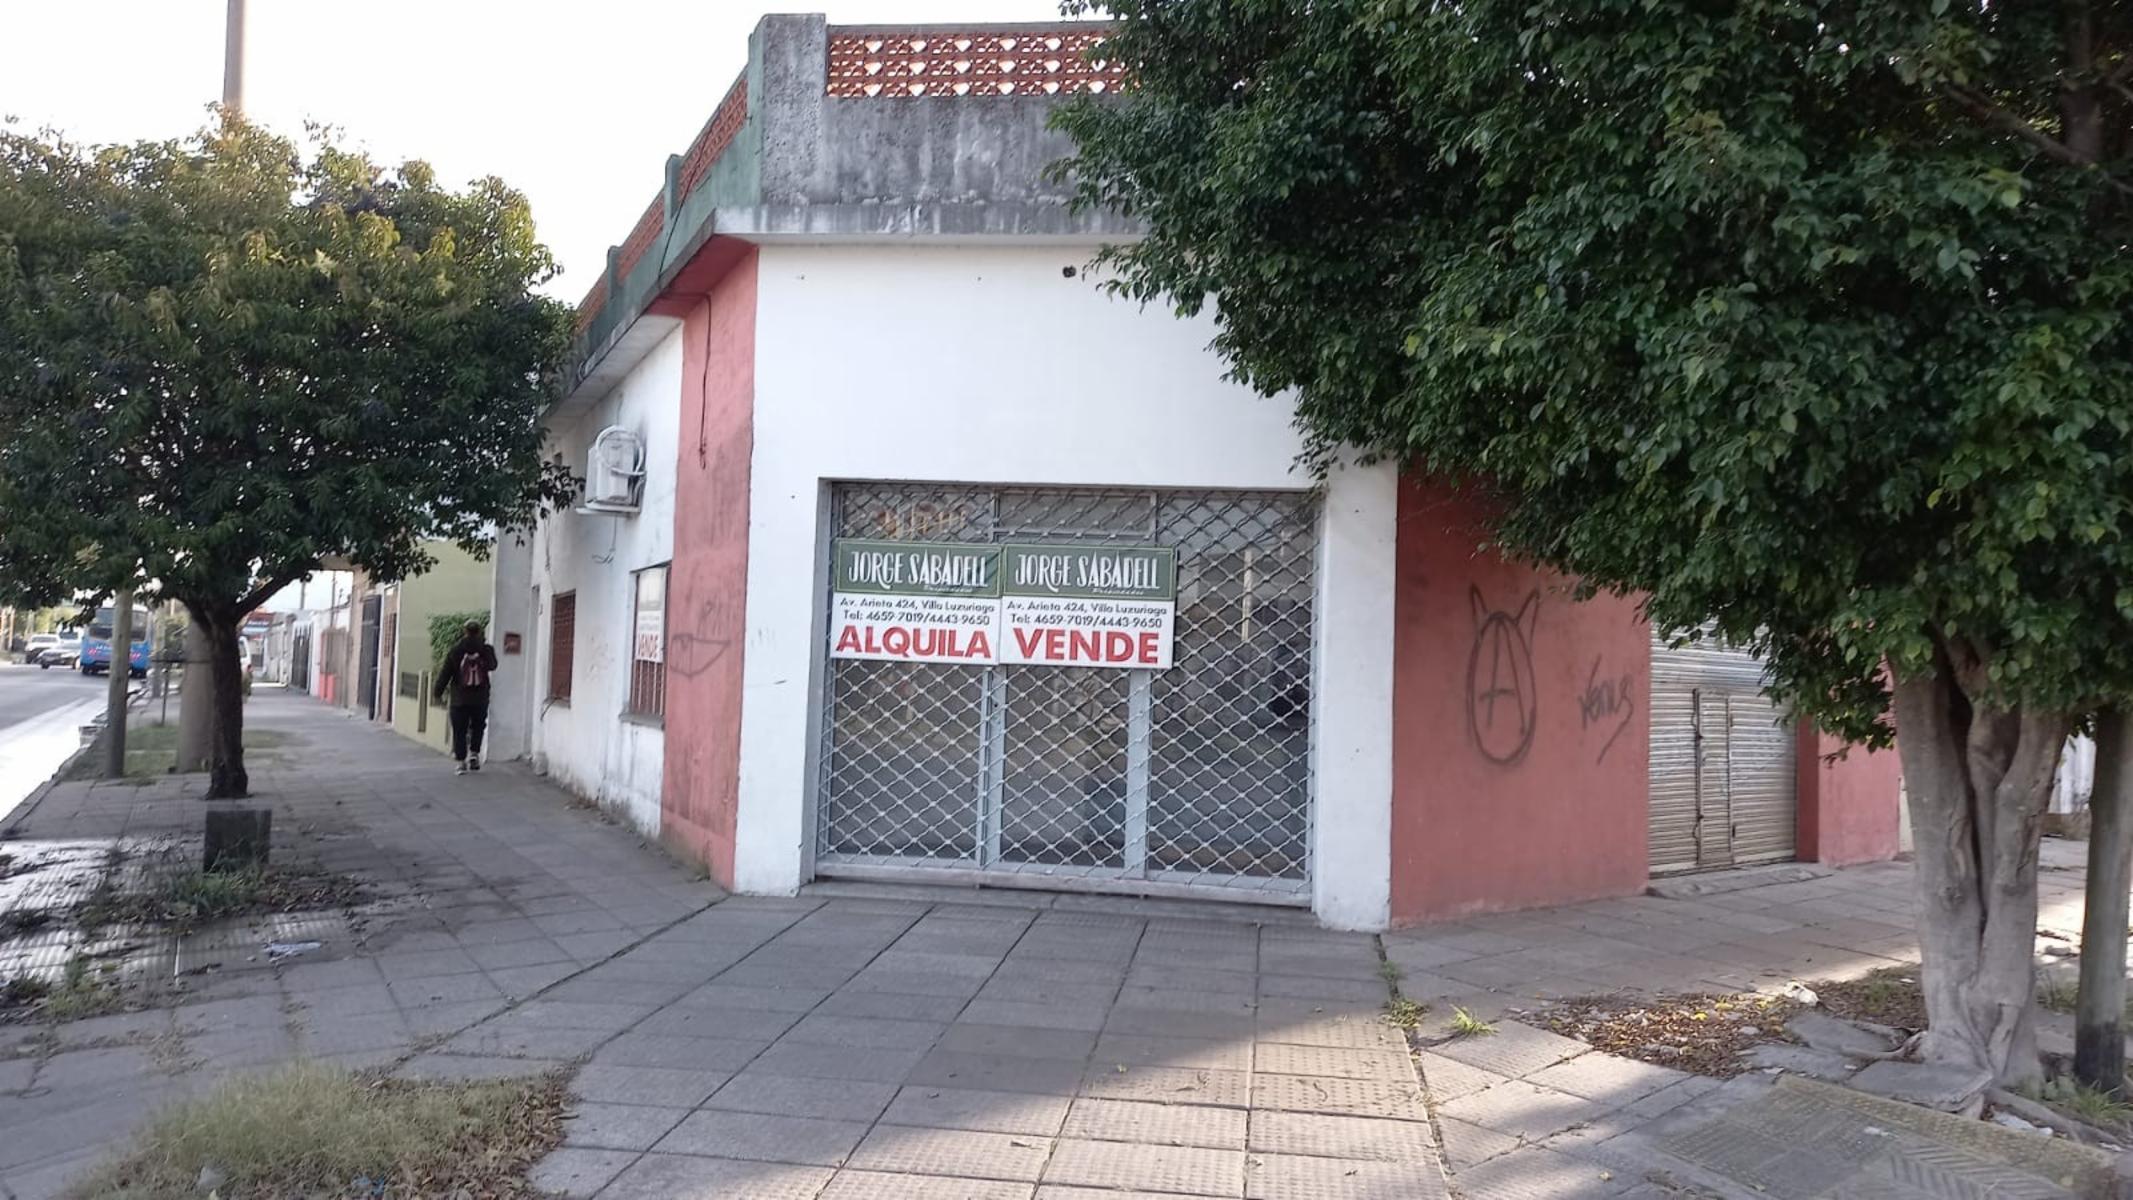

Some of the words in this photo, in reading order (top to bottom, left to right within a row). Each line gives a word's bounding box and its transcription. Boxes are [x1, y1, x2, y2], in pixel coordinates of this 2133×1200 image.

[848, 551, 904, 589] JORGE
[908, 549, 988, 587] SABADELL
[1015, 554, 1072, 592] JORGE
[1077, 551, 1160, 589] SABADELL
[843, 610, 863, 620] Tel:
[1011, 613, 1031, 623] Tel:
[1091, 603, 1113, 613] Villa
[1115, 603, 1167, 617] Luzuriaga
[835, 625, 992, 658] ALQUILA
[1013, 628, 1159, 663] VENDE
